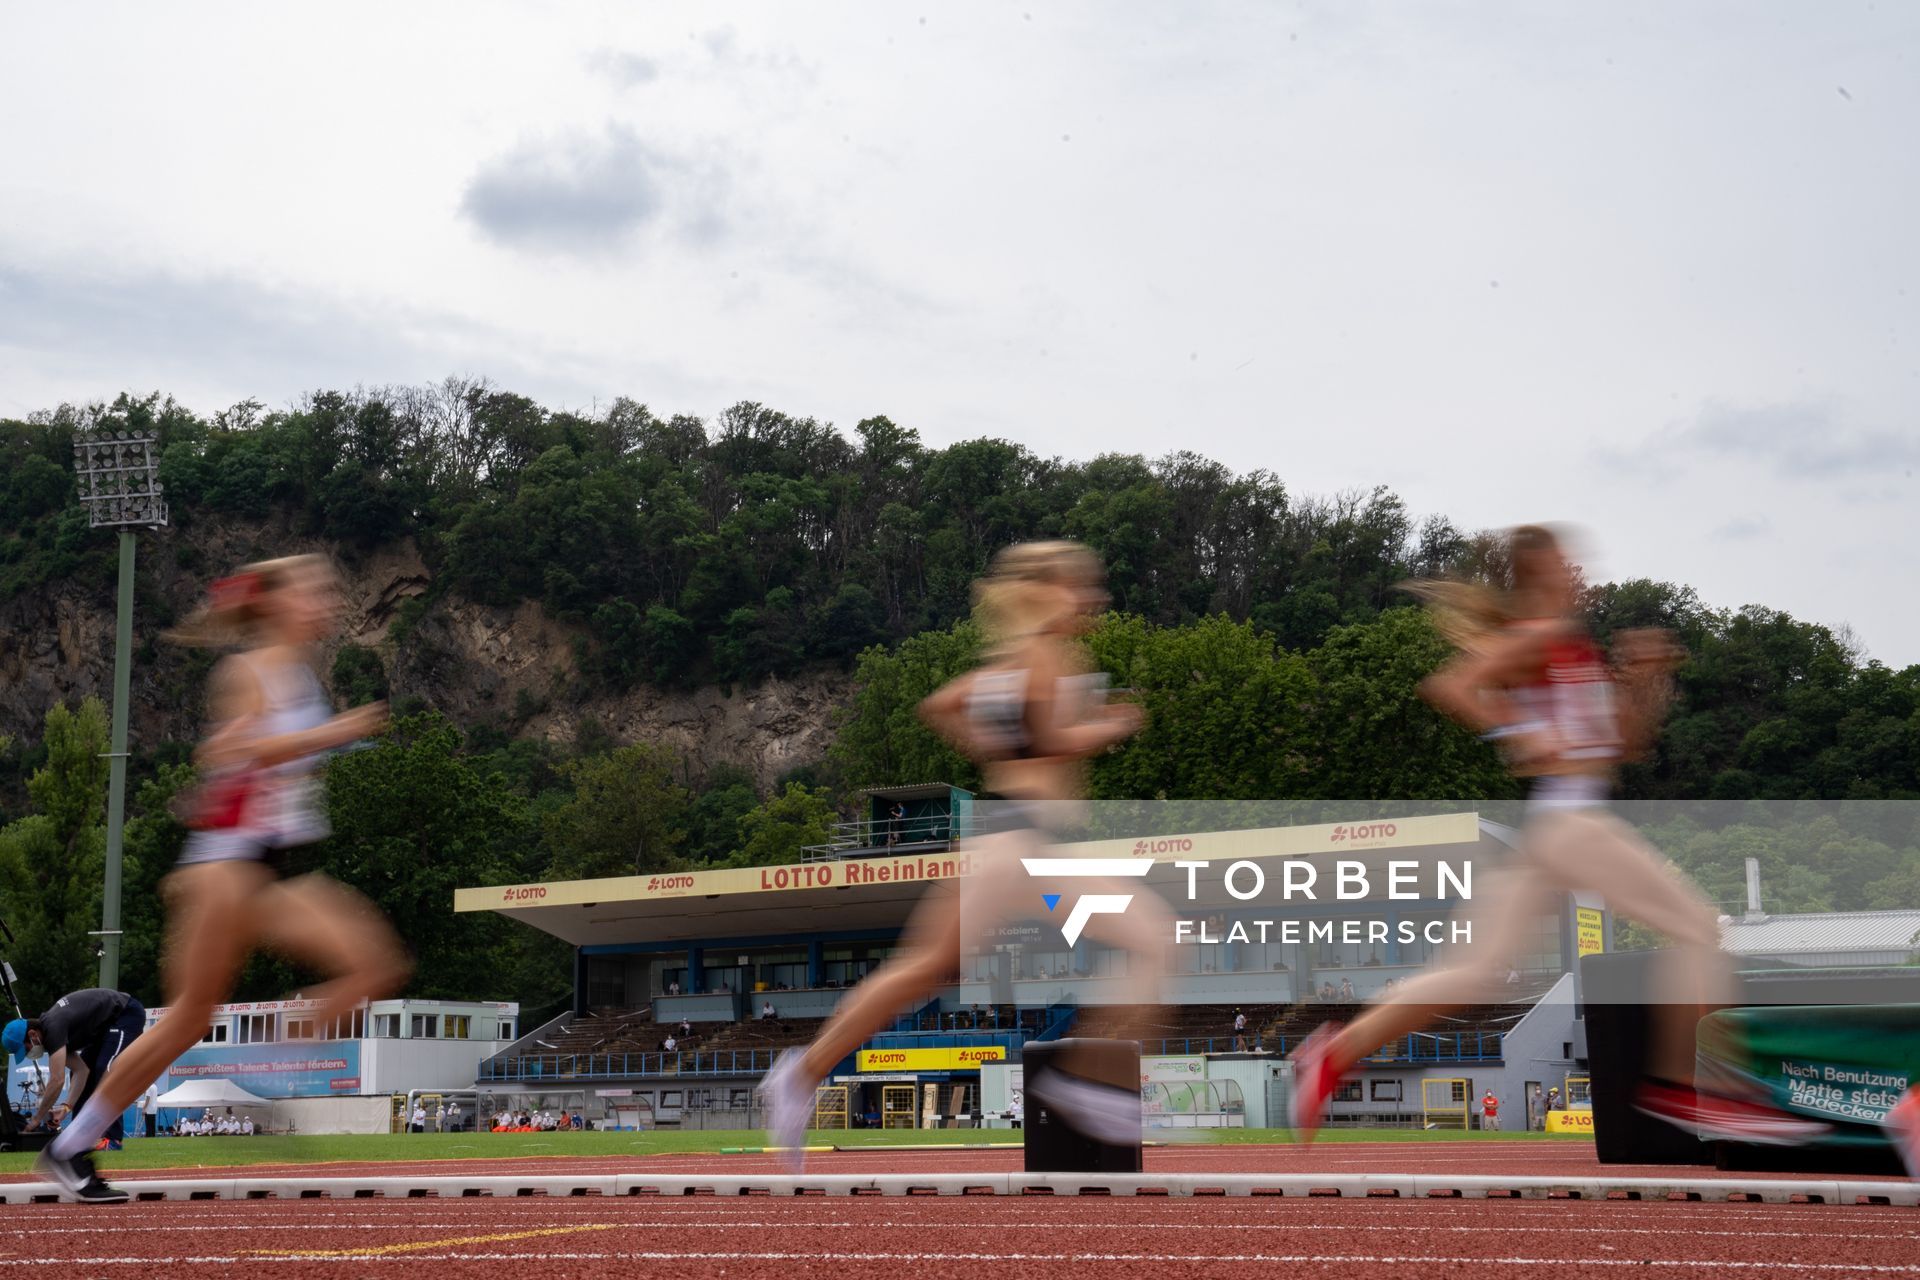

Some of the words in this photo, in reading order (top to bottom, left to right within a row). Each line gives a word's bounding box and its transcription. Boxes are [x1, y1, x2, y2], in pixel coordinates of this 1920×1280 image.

[1351, 823, 1397, 840] LOTTO
[1150, 838, 1193, 854] LOTTO
[662, 876, 694, 890] LOTTO
[761, 865, 832, 890] LOTTO
[516, 887, 547, 900] LOTTO
[262, 1002, 278, 1010] LOTTO
[289, 1000, 305, 1008] LOTTO
[879, 1053, 906, 1063] LOTTO
[970, 1051, 999, 1061] LOTTO
[169, 1065, 197, 1076] Unser
[198, 1064, 236, 1075] größtes
[272, 1062, 305, 1072] Talente
[308, 1060, 347, 1070] fördern.
[1781, 1061, 1819, 1079] Nach
[1824, 1067, 1907, 1090] Benutzung
[1788, 1079, 1844, 1100] Matte
[1850, 1088, 1899, 1108] stets
[1791, 1092, 1887, 1120] abdecken
